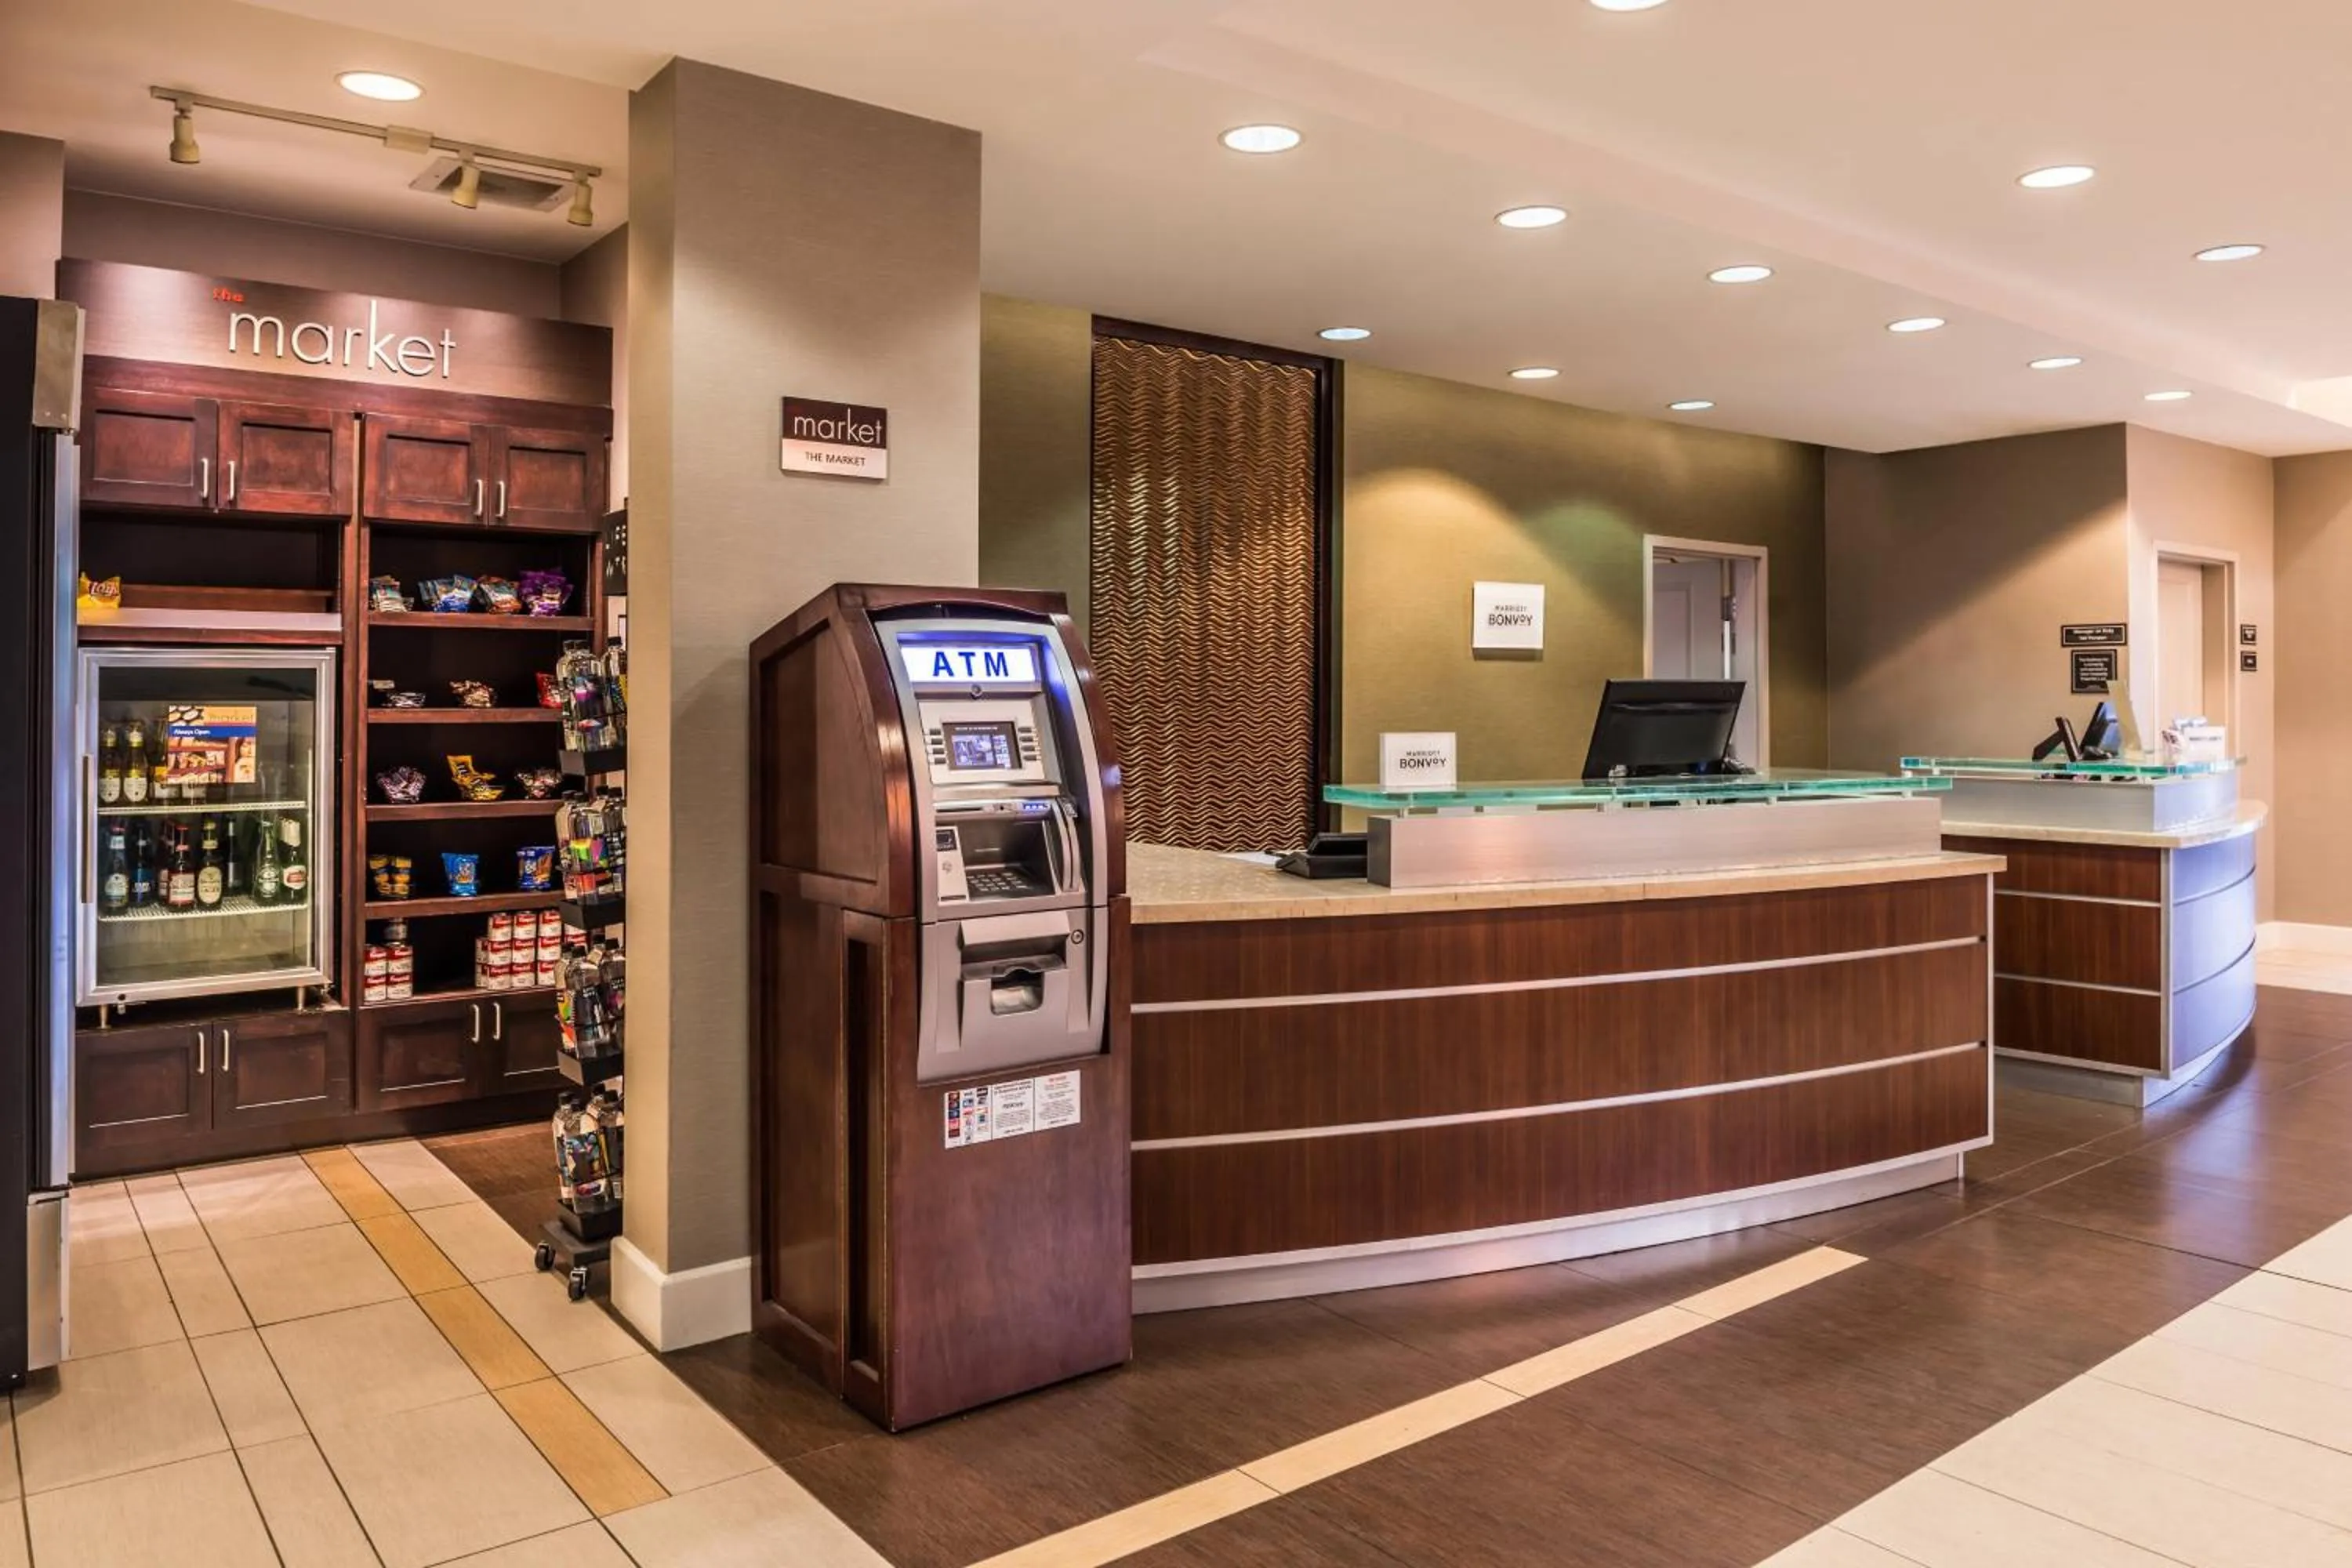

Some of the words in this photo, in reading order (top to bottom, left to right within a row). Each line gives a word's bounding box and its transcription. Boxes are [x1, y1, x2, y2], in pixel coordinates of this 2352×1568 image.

[228, 299, 456, 377] market
[794, 408, 882, 444] market
[805, 451, 822, 463] THE
[826, 454, 866, 466] MARKET
[933, 652, 1009, 677] ATM
